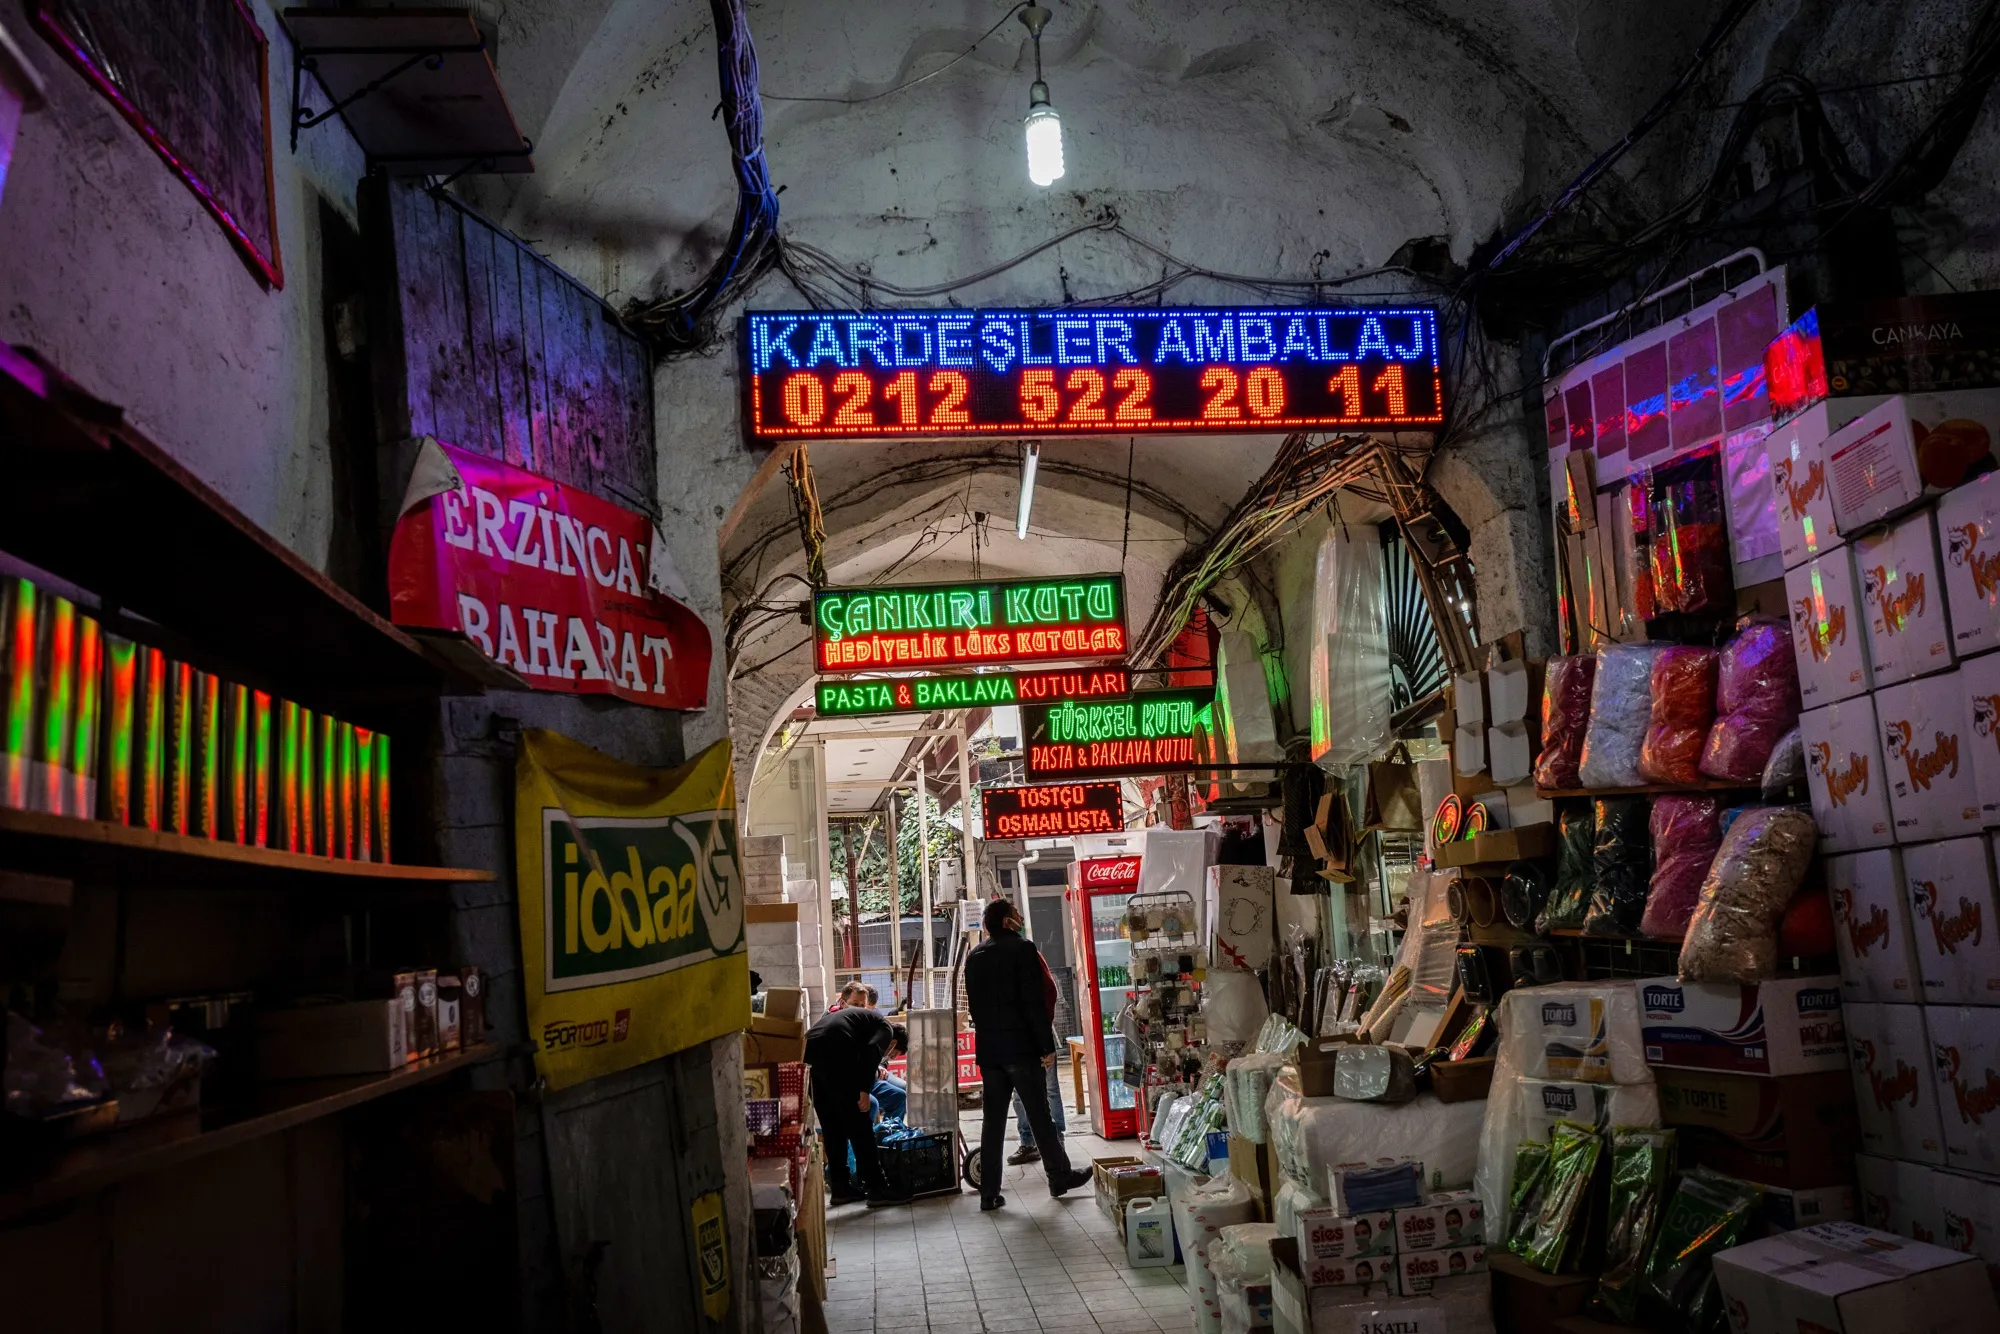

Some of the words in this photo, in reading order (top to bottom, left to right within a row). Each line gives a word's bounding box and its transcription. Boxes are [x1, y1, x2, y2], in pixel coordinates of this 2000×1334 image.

[760, 319, 1138, 372] KARDEŞLER
[1155, 317, 1424, 361] AMBALAJ
[784, 371, 969, 426] 0212
[1020, 368, 1152, 423] 522
[1201, 366, 1286, 418] 20
[1328, 365, 1405, 416] 11
[821, 590, 992, 641] ÇANKIRI
[1006, 584, 1113, 624] KUTU
[458, 591, 673, 694] BAHARAT
[825, 633, 948, 665] HEDİYELİK
[954, 631, 1010, 656] LÜKS
[1017, 628, 1122, 653] KUTULAR
[823, 685, 893, 709] PASTA
[898, 684, 911, 704] &
[917, 677, 1014, 704] BAKLAVA
[1019, 673, 1126, 698] KUTULARI
[1049, 701, 1137, 742] TÜRKSEL
[1142, 701, 1193, 738] KUTU
[1032, 745, 1073, 771] PASTA
[1078, 747, 1087, 767] &
[1091, 740, 1151, 767] BAKLAVA
[998, 812, 1062, 834] OSMAN
[1067, 809, 1111, 830] USTA
[565, 843, 697, 955] iddaa
[1647, 992, 1680, 1007] TORTE
[1544, 1008, 1573, 1021] TORTE
[1545, 1091, 1573, 1107] TORTE
[1682, 1088, 1728, 1110] TORTE
[1312, 1224, 1344, 1243] sies
[1404, 1214, 1436, 1234] sies
[1312, 1265, 1345, 1284] sies
[1407, 1257, 1439, 1277] sies
[1373, 1321, 1418, 1334] KATLI
